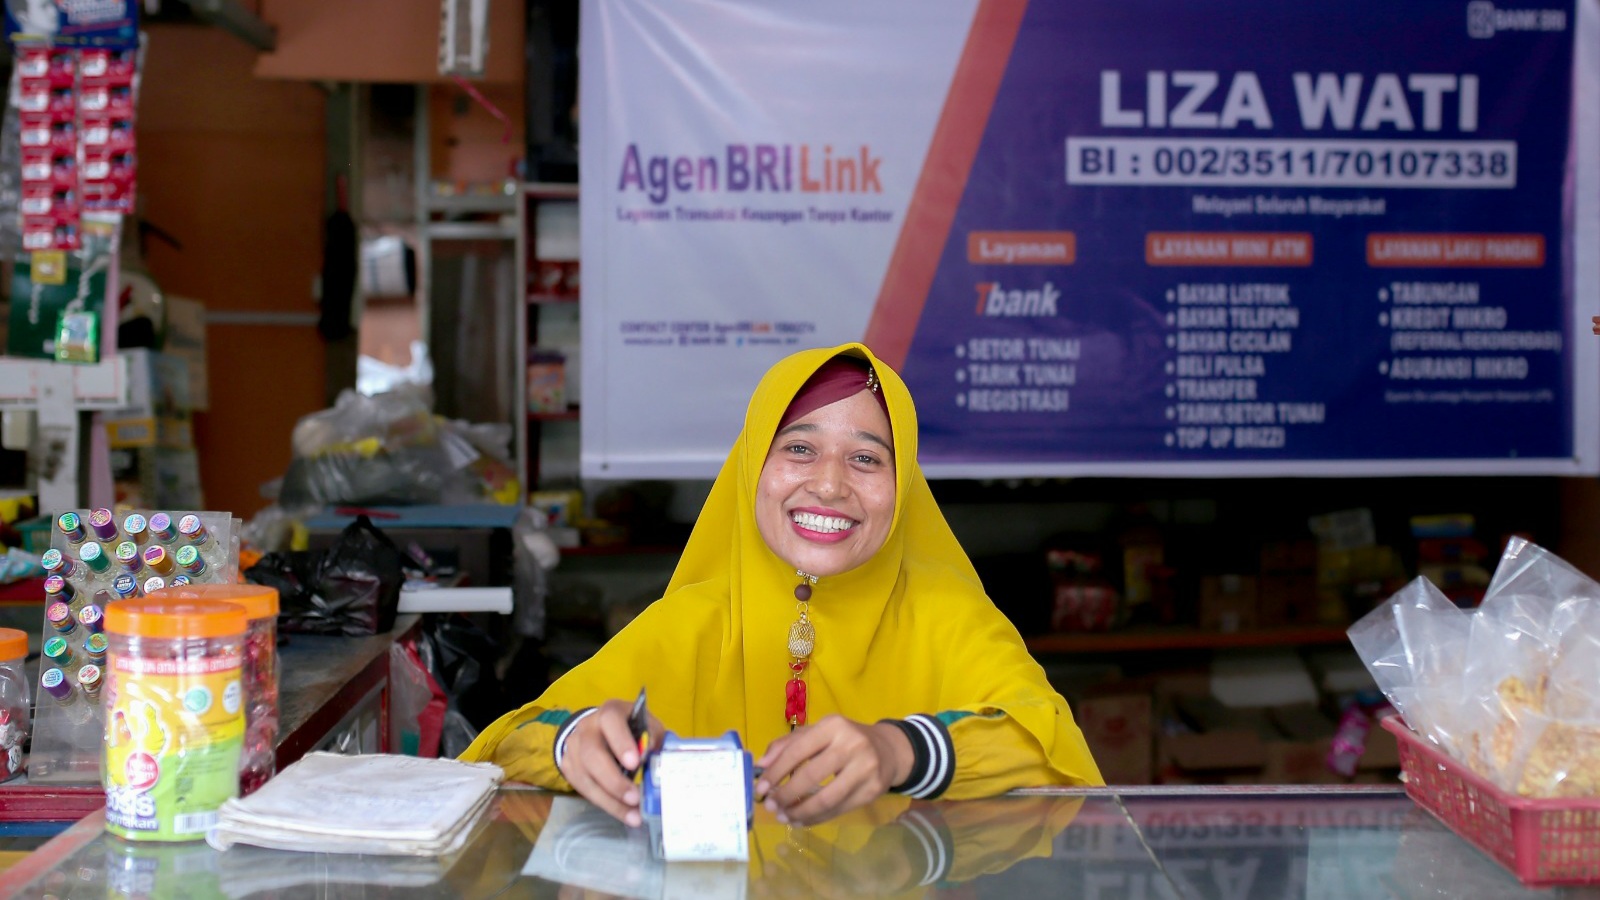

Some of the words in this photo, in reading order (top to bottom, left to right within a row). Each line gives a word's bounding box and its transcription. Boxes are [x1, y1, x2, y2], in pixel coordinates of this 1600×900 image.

[1100, 70, 1273, 129] LIZA
[1293, 72, 1479, 132] WATI
[1079, 147, 1116, 175] BI
[1153, 147, 1509, 178] 002/3511/70107338
[616, 206, 671, 223] Layanan
[675, 207, 736, 222] Transaksi
[808, 207, 846, 223] Tanpa
[850, 207, 894, 222] Kantor
[979, 239, 1067, 263] Layanan
[1152, 238, 1227, 258] LAYANAN
[1232, 239, 1268, 257] MINI
[1271, 239, 1306, 258] ATM
[1373, 240, 1441, 260] LAYANAN
[974, 281, 1061, 316] Tbank
[1177, 283, 1228, 305] BAYAR
[1229, 283, 1290, 305] LISTRIK
[1390, 282, 1480, 304] TABUNGAN
[1177, 306, 1228, 328] BAYAR
[1229, 307, 1299, 329] TELEPON
[1390, 306, 1451, 329] KREDIT
[1452, 306, 1507, 329] MIKRO
[968, 339, 1025, 361] SETOR
[1028, 339, 1081, 361] TUNAI
[1177, 331, 1228, 352] BAYAR
[1229, 331, 1291, 353] CICILAN
[968, 364, 1020, 386] TARIK
[1023, 364, 1077, 386] TUNAI
[1177, 355, 1212, 376] BELI
[1214, 355, 1265, 377] PULSA
[1390, 357, 1472, 379] ASURANSI
[1474, 357, 1529, 379] MIKRO
[968, 389, 1069, 412] REGISTRASI
[1176, 379, 1257, 401] TRANSFER
[1277, 403, 1326, 424] TUNAI
[1177, 427, 1208, 449] TOP
[1209, 427, 1232, 449] UP
[1234, 427, 1286, 449] BRIZZI
